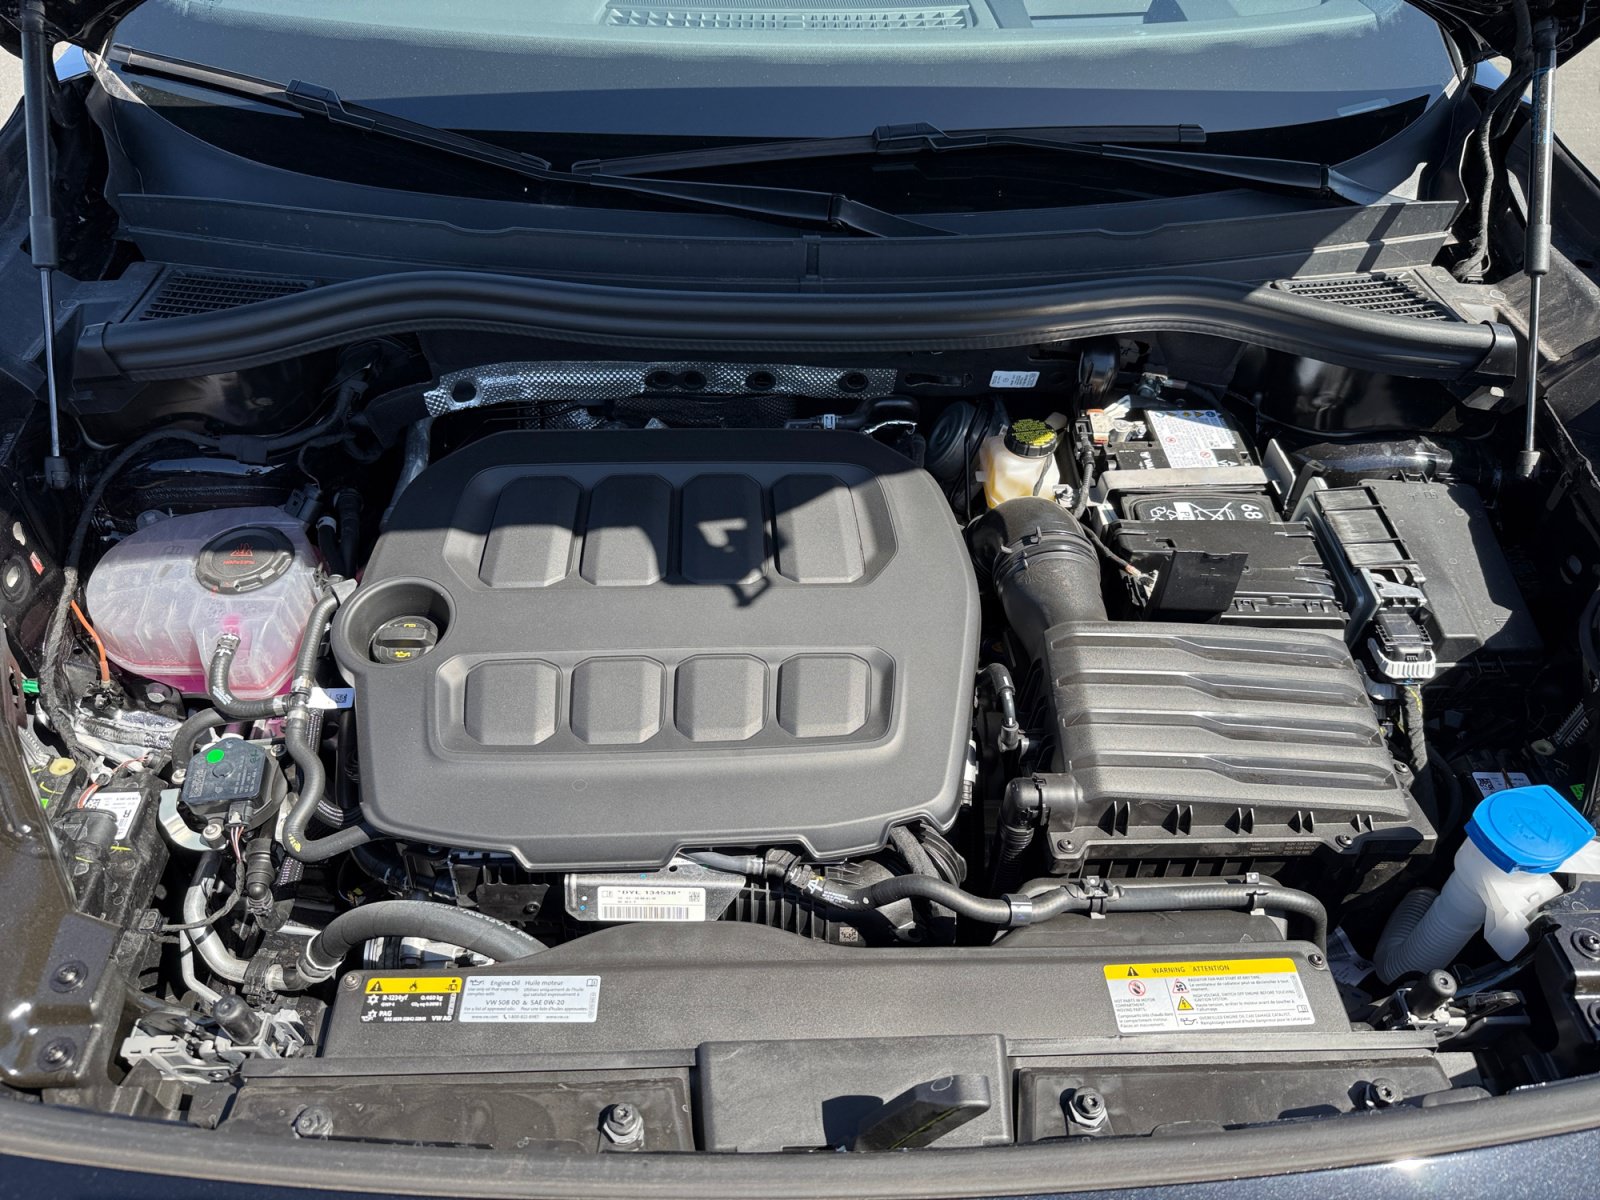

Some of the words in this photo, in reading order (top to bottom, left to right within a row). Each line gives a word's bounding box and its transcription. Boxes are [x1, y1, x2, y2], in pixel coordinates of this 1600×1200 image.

[1240, 504, 1264, 520] 68
[1152, 966, 1186, 974] WARNING
[1192, 964, 1230, 972] ATTENTION
